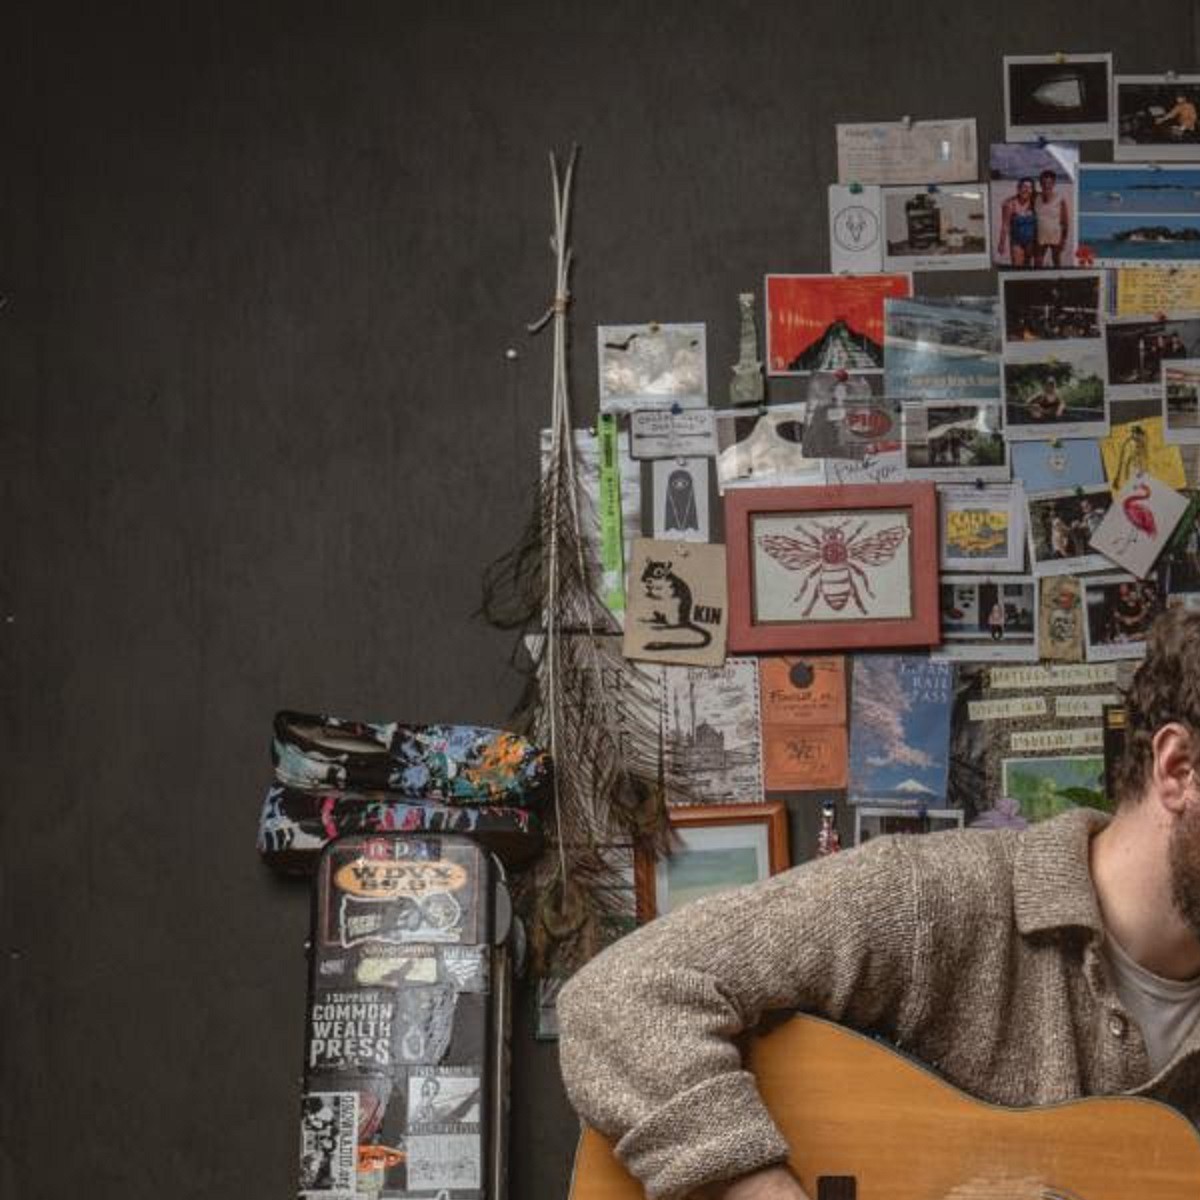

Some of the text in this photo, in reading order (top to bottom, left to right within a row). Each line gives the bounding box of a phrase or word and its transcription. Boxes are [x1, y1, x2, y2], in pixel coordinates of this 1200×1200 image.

[693, 605, 722, 625] KIN
[312, 1004, 393, 1021] COMMON
[312, 1021, 391, 1039] WEALTH
[309, 1038, 390, 1067] PRESS
